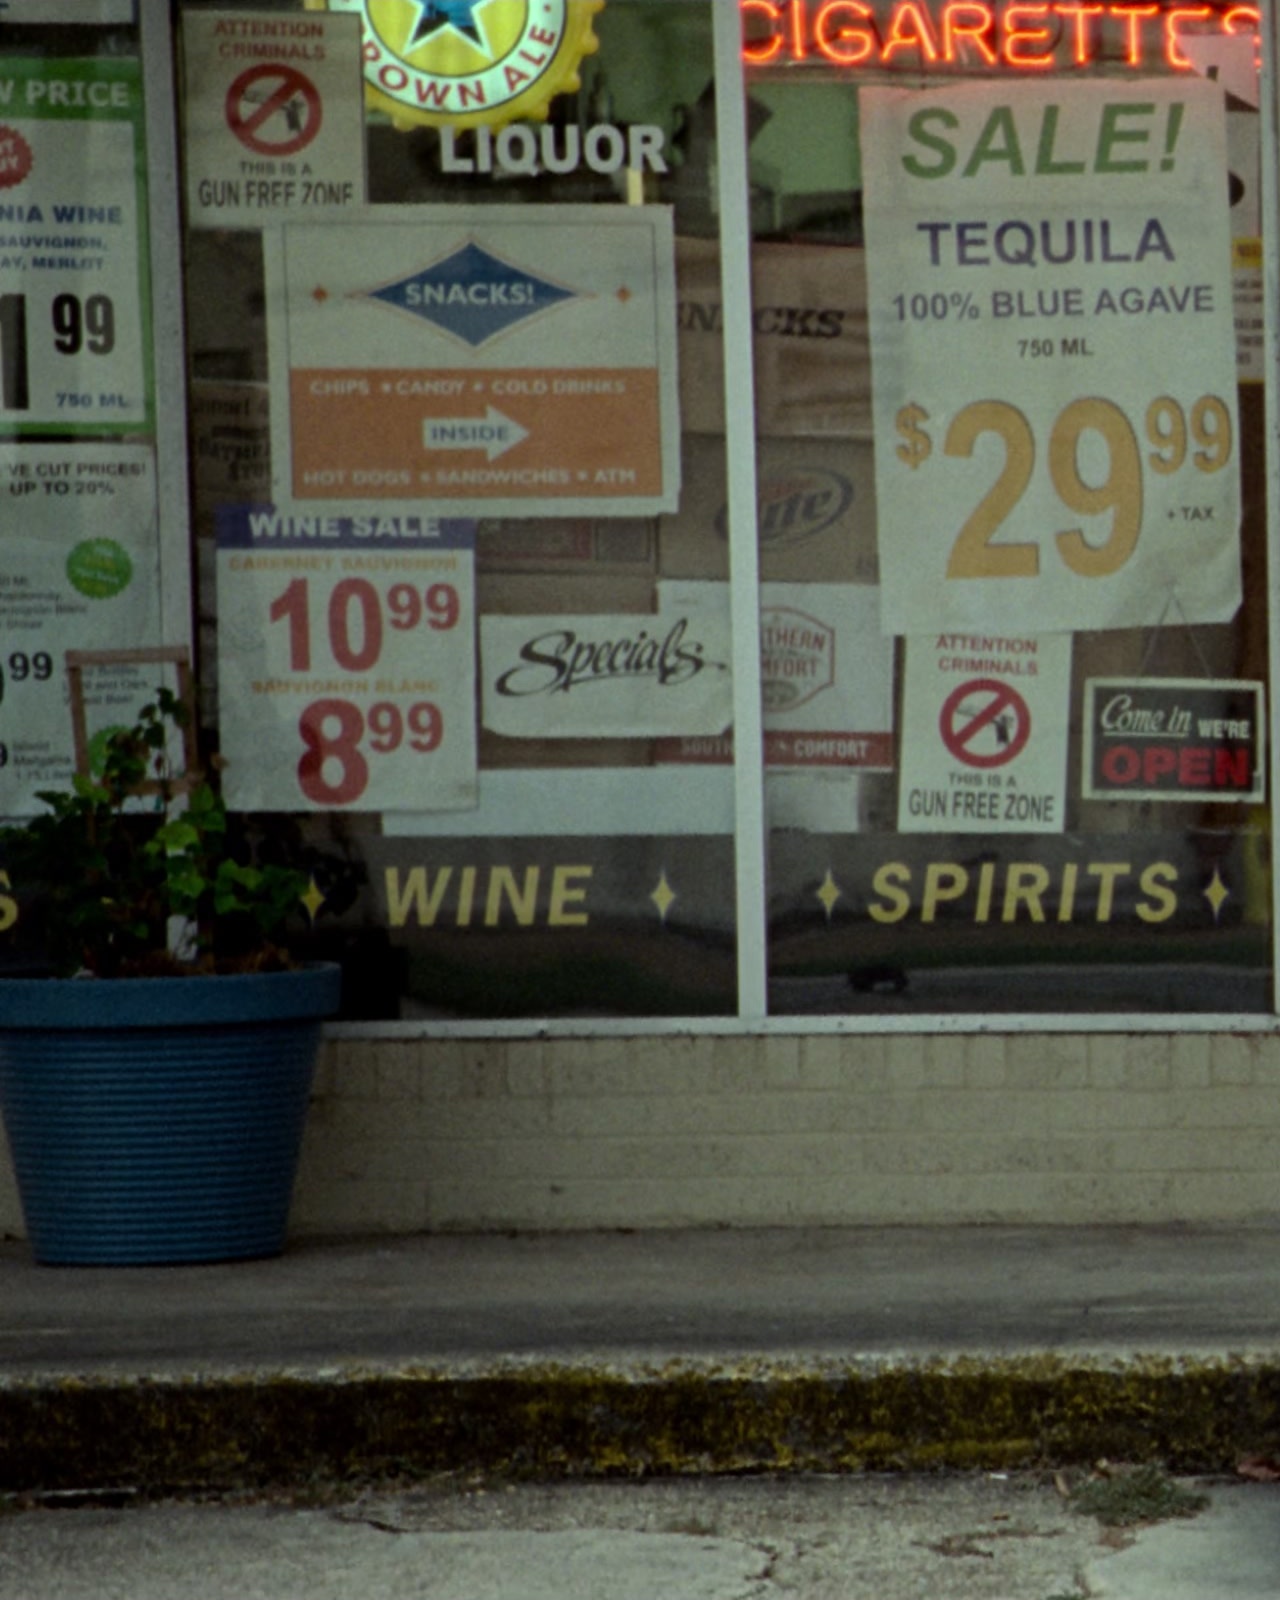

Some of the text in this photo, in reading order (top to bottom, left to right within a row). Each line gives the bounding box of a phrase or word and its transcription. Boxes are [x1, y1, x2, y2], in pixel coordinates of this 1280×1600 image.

[214, 21, 324, 39] ATTENTION
[218, 42, 326, 60] CRIMINALS
[503, 25, 557, 91] ALE
[26, 80, 130, 107] PRICE
[439, 123, 668, 177] LIQUOR
[901, 102, 1184, 180] SALE!
[240, 161, 313, 176] THIS IS A
[199, 180, 353, 209] GUN FREE ZONE
[53, 205, 122, 225] WINE
[917, 218, 1176, 266] TEQUILA
[32, 256, 104, 275] MERLOT
[406, 283, 536, 307] SNACKS!
[892, 285, 1216, 321] 100% BLUE AGAVE
[1018, 338, 1094, 357] 750 ML
[310, 380, 627, 396] CHIPS CANDY COLD DRINKS
[56, 392, 129, 408] 750 ML
[431, 426, 511, 443] INSIDE
[36, 463, 70, 478] CUT
[77, 461, 146, 477] PRICES!
[304, 469, 646, 487] HOT DOGS SANDWICHES ATM
[10, 481, 115, 496] UP TO 20%
[1181, 506, 1215, 521] TAX
[249, 513, 441, 538] WINE SALE
[229, 557, 458, 570] CABERNET SAUVIGNON
[936, 633, 1038, 653] ATTENTION
[496, 617, 728, 698] Specials
[938, 657, 1039, 676] CRIMINALS
[251, 680, 368, 694] SAUVIGNON
[1101, 695, 1251, 738] Come in WE'RE
[793, 739, 869, 760] COMFORT
[1101, 745, 1251, 788] OPEN
[949, 773, 1017, 787] THIS IS A
[908, 789, 1055, 823] GUN FREE ZONE
[382, 861, 1181, 928] WINE SPIRITS
